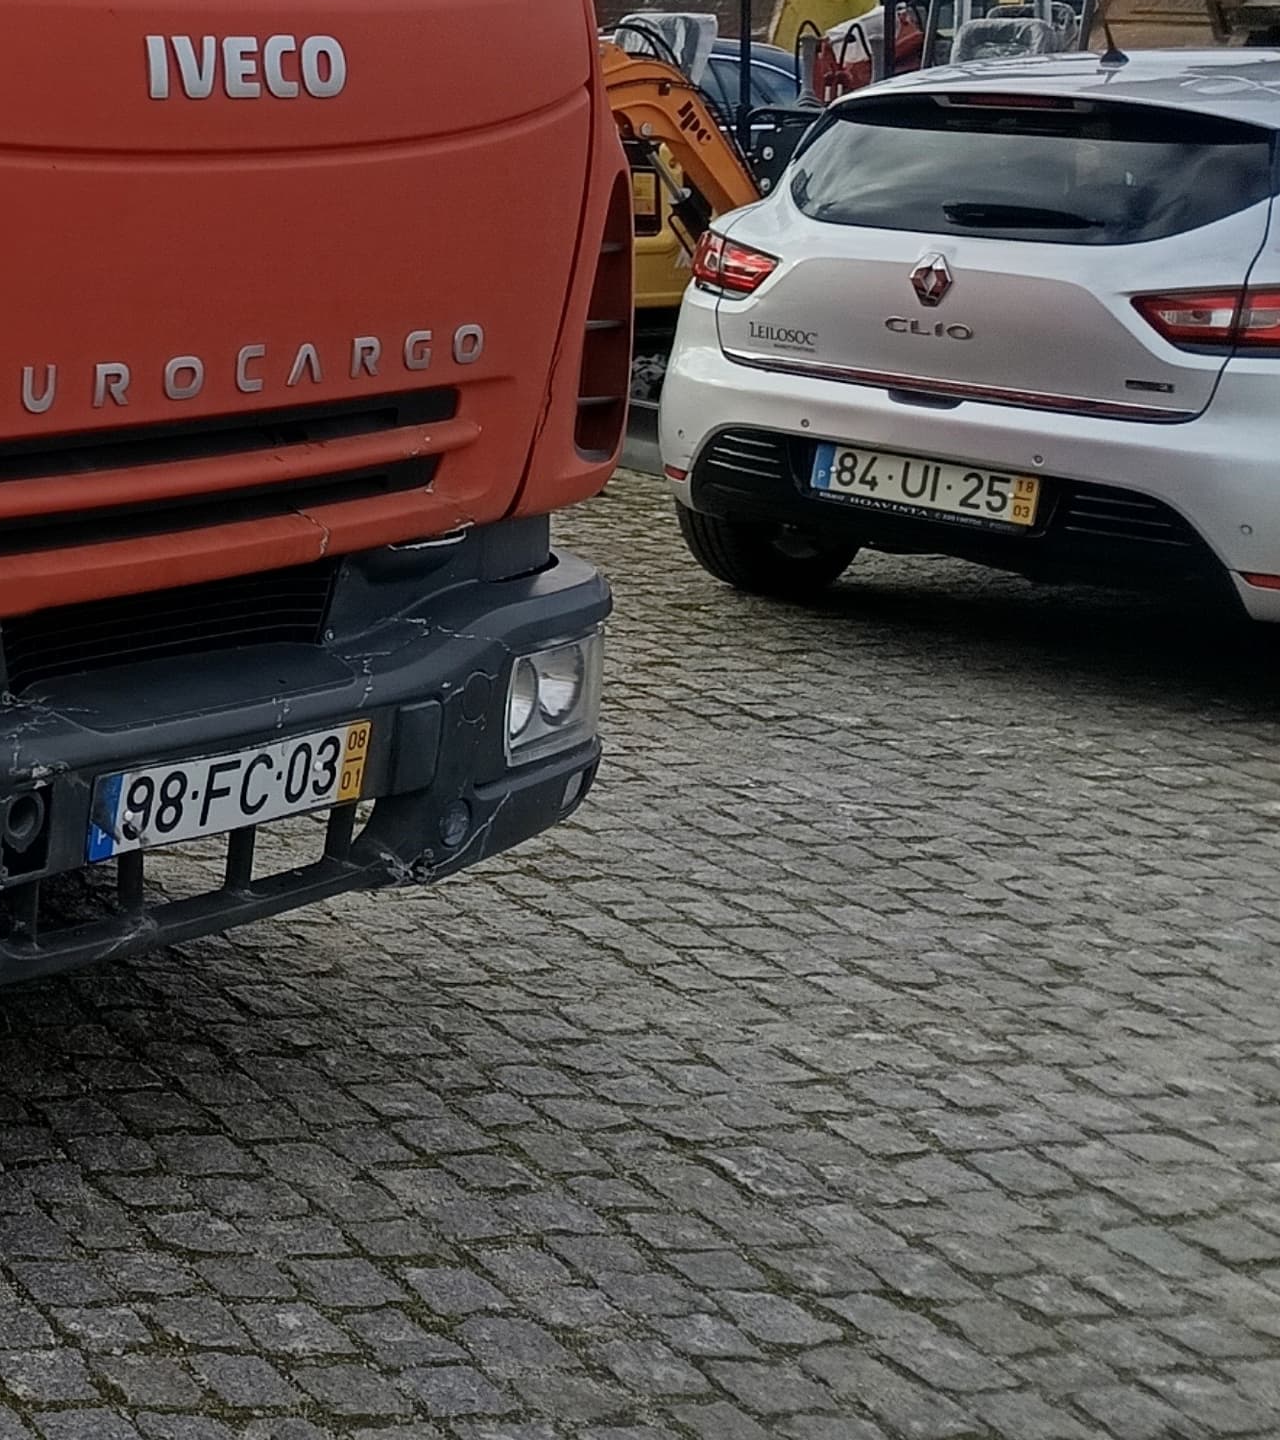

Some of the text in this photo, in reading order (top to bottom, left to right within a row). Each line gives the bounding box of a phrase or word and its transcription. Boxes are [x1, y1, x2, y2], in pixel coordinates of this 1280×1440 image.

[145, 34, 347, 99] IVECO
[749, 321, 818, 346] LEILOSOC
[884, 315, 974, 340] CLIO
[1015, 478, 1035, 493] 18
[1012, 504, 1030, 518] 03
[348, 729, 368, 750] 08
[341, 769, 361, 791] 01
